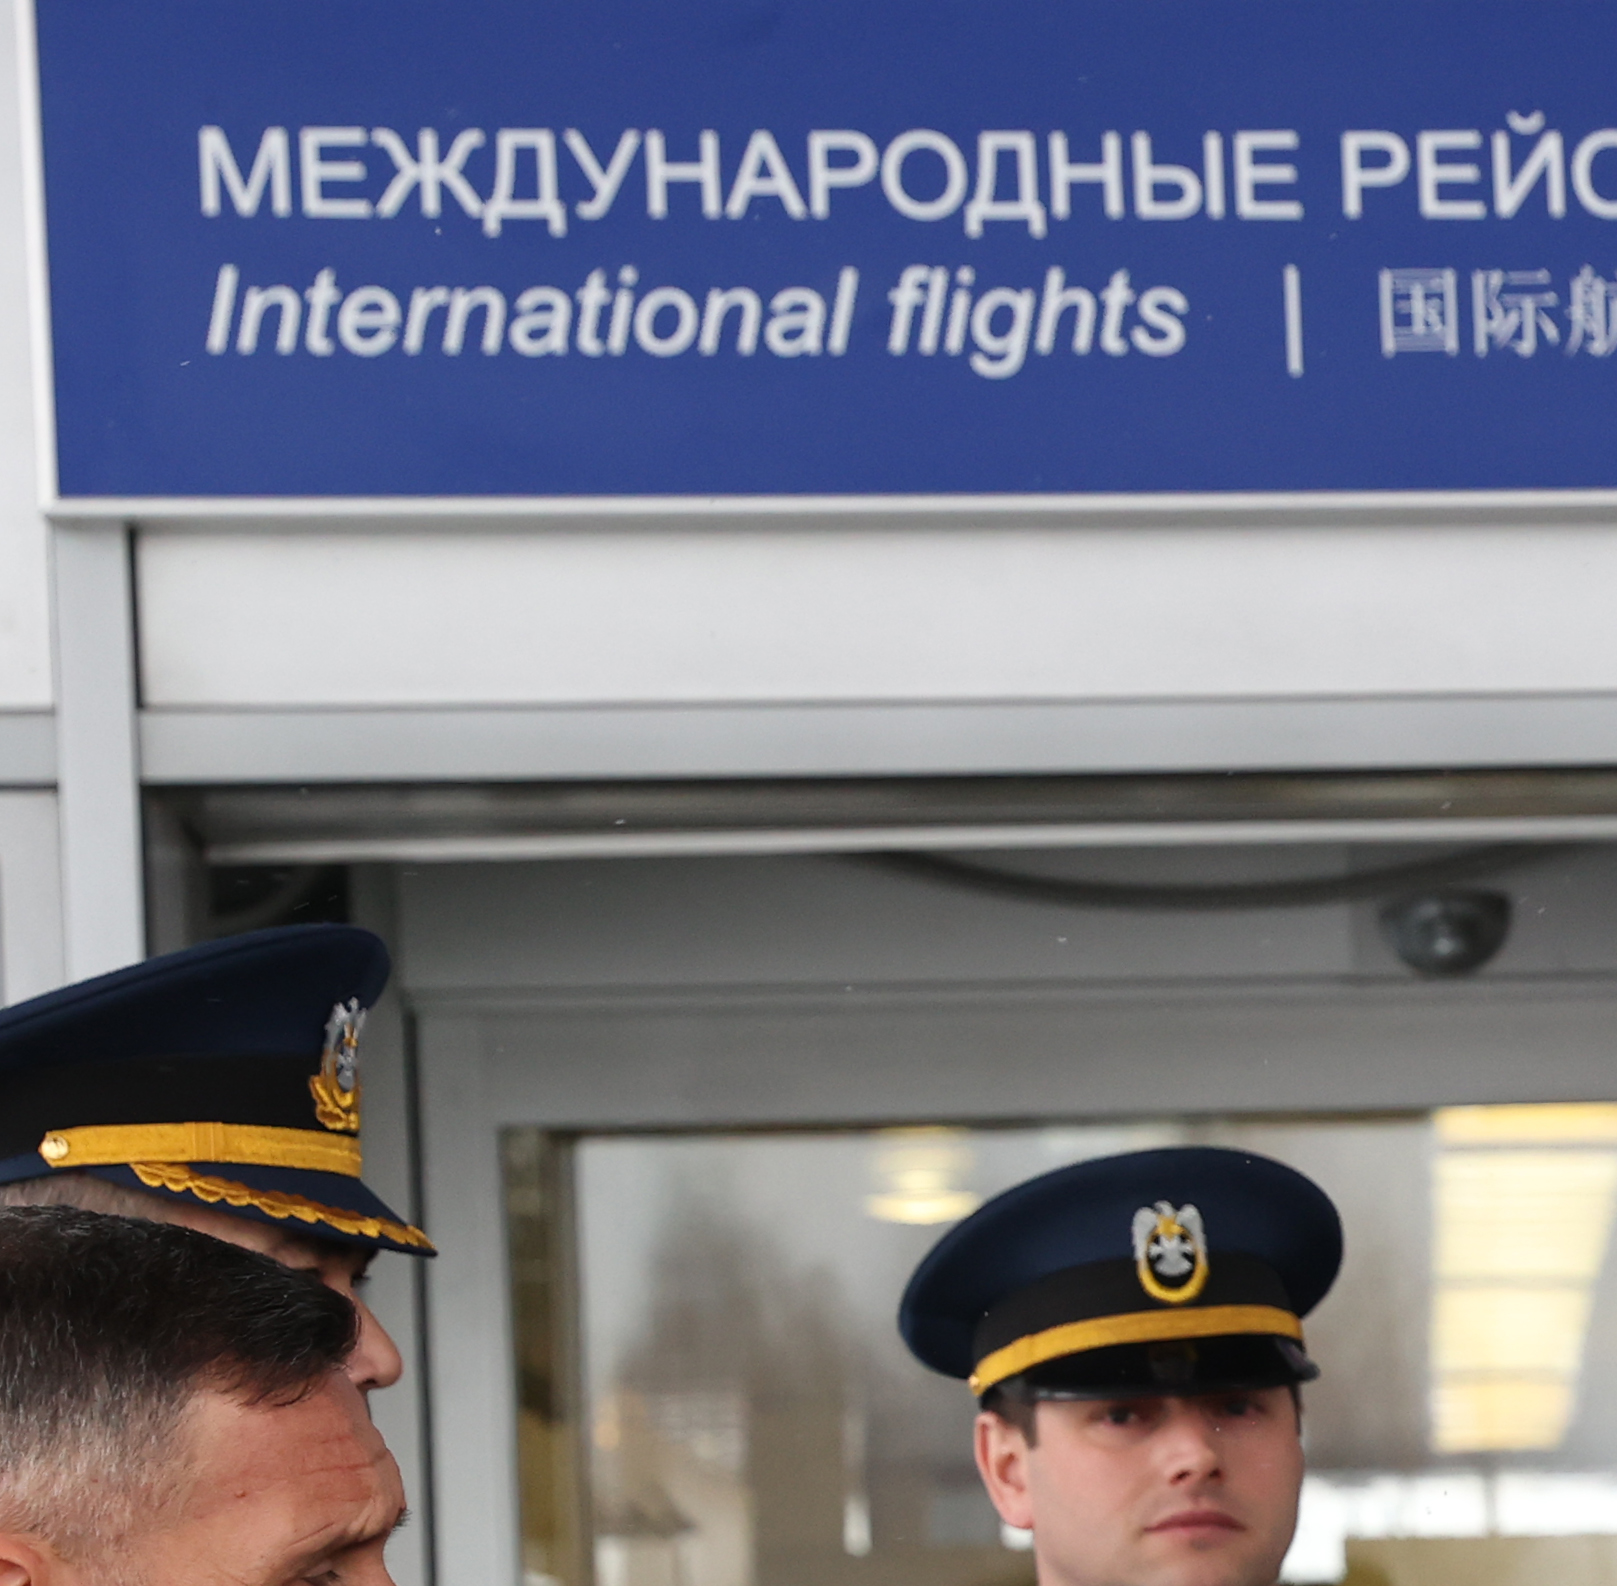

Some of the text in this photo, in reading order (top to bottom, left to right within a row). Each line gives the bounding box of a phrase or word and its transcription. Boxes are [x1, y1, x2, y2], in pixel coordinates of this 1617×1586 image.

[197, 124, 1305, 234] МЕЖДУНАРОДНЫЕ
[204, 262, 1189, 380] International flights
